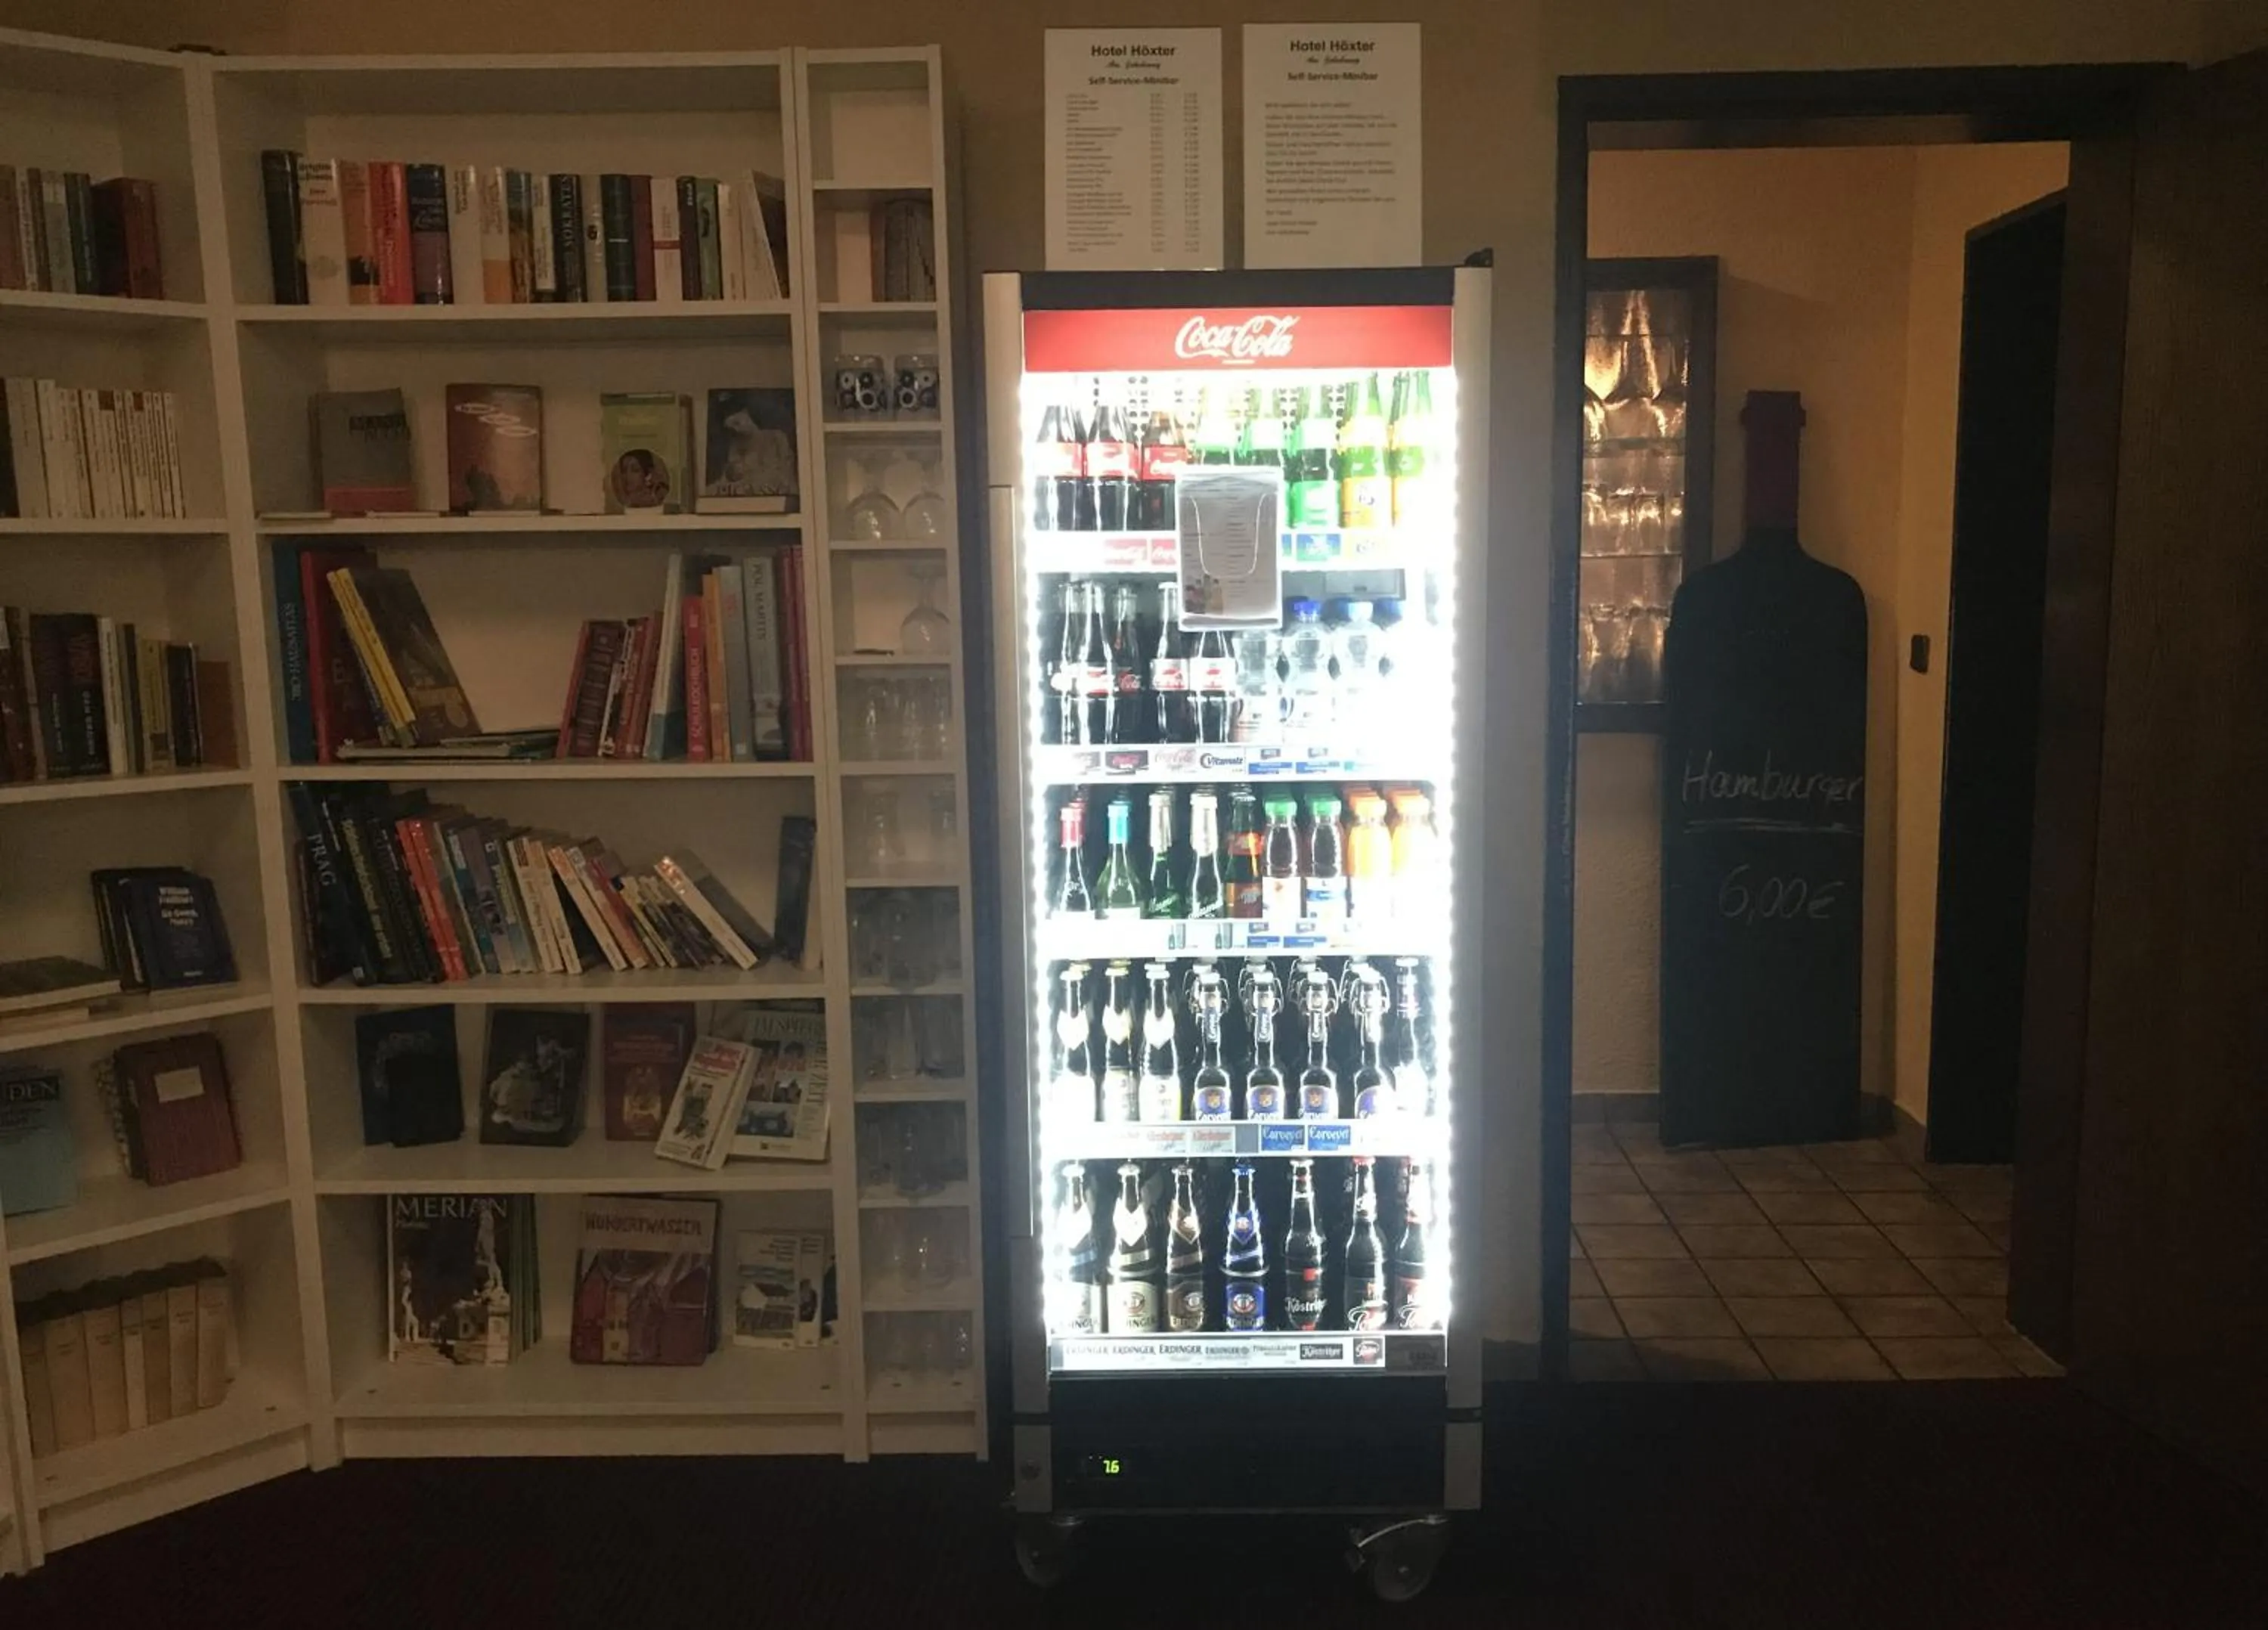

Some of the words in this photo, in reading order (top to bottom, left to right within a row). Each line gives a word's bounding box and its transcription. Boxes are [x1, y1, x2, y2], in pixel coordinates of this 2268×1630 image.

[1090, 45, 1126, 57] Hotel
[1131, 44, 1176, 57] Höxter
[1290, 40, 1325, 52] Hotel
[1330, 39, 1375, 52] Höxter
[1174, 314, 1301, 359] Coca-Cola
[1682, 749, 1864, 805] Hamburger
[306, 832, 337, 887] PRAG
[1719, 863, 1845, 926] 6,00€
[395, 1196, 508, 1219] MERIAN
[1159, 1343, 1203, 1355] ERDINGER
